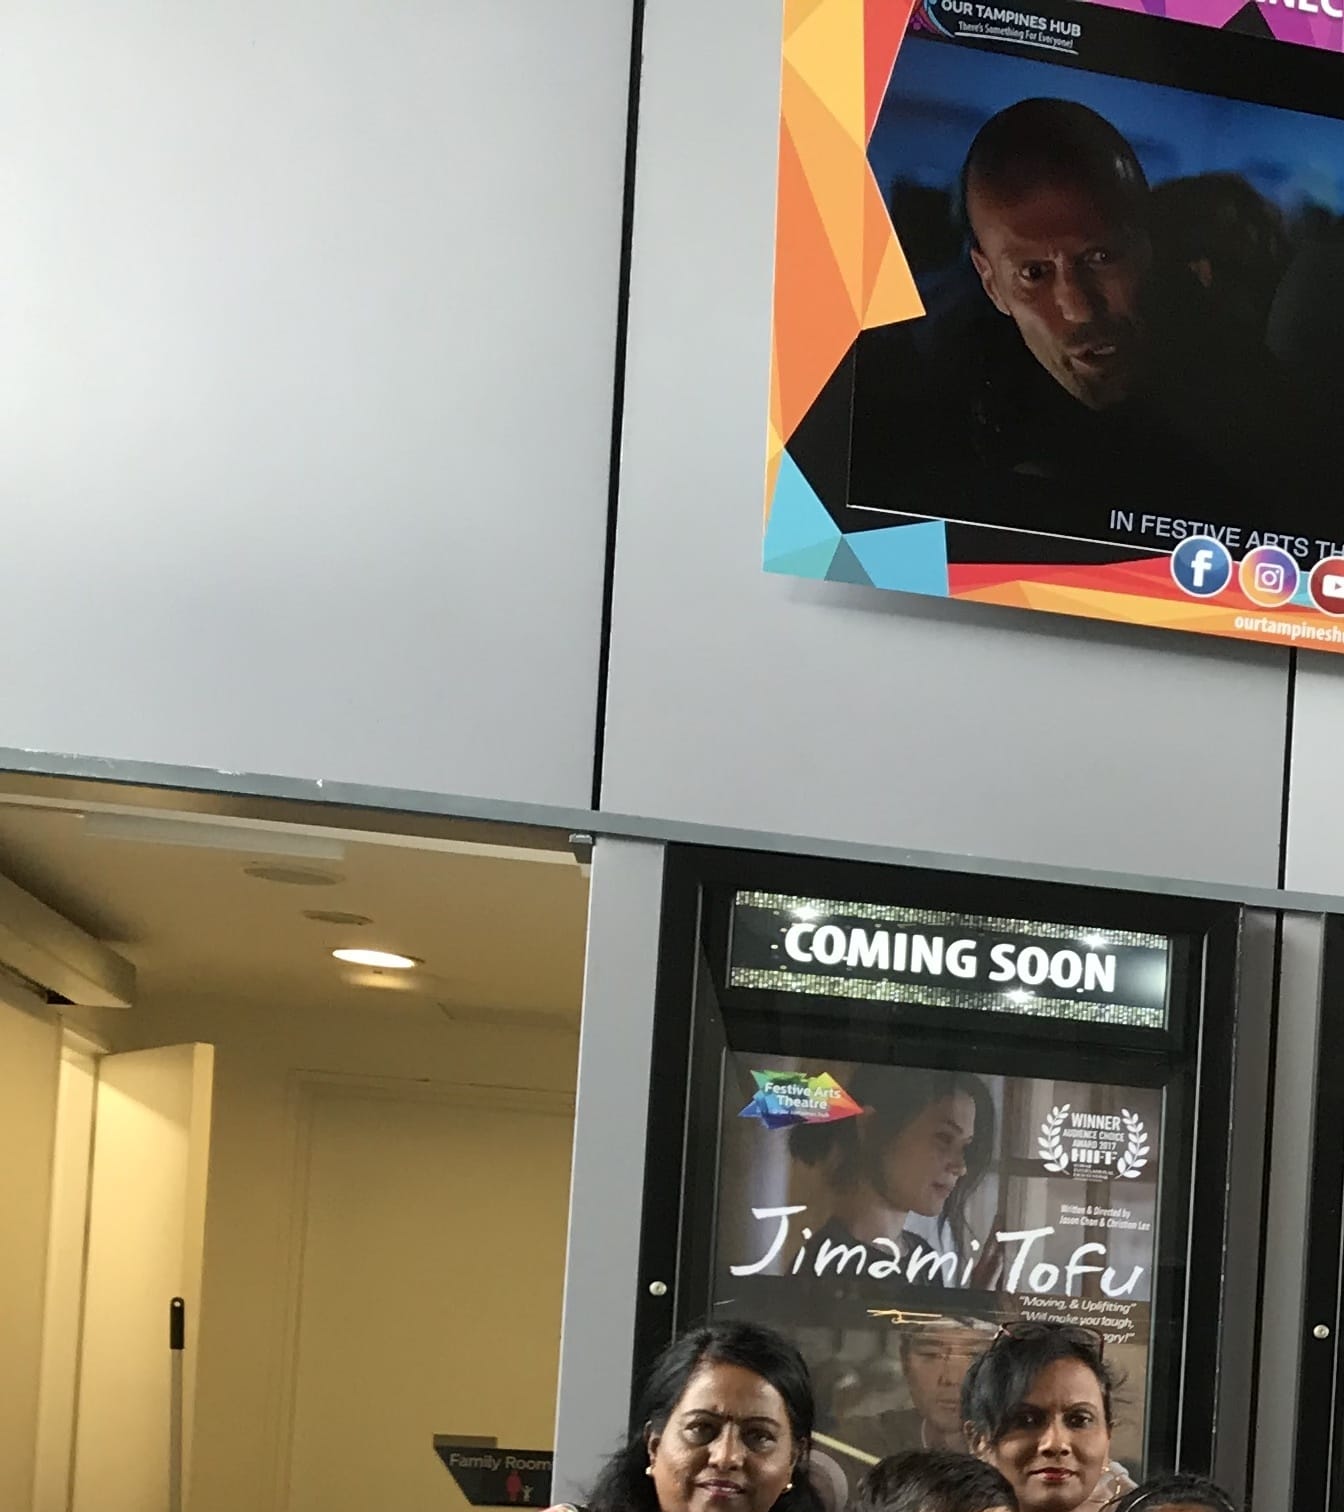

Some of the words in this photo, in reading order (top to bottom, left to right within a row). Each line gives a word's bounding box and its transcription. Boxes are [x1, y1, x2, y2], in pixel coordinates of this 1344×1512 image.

[941, 0, 973, 16] OUR
[975, 4, 1047, 30] TAMPINES
[1049, 19, 1081, 37] HUB
[985, 23, 1025, 40] Something
[1109, 509, 1133, 531] IN
[1141, 514, 1241, 547] FESTIVE
[1245, 529, 1309, 558] ARTS
[784, 923, 977, 980] COMING
[989, 943, 1117, 994] SOON
[764, 1081, 811, 1097] Festive
[814, 1086, 841, 1099] Arts
[776, 1094, 828, 1110] Theatre
[1071, 1112, 1121, 1131] WINNER
[1062, 1128, 1098, 1140] AUDIENCE
[1098, 1131, 1125, 1142] CHOICE
[1072, 1139, 1098, 1150] AWARD
[1098, 1141, 1117, 1151] 2017
[1093, 1206, 1121, 1218] Directed
[1122, 1208, 1131, 1219] by
[730, 1205, 980, 1284] Jimami
[996, 1226, 1145, 1296] Tofu
[1068, 1299, 1079, 1310] &
[1080, 1317, 1101, 1327] you
[449, 1453, 500, 1472] Family
[505, 1456, 553, 1471] Room
